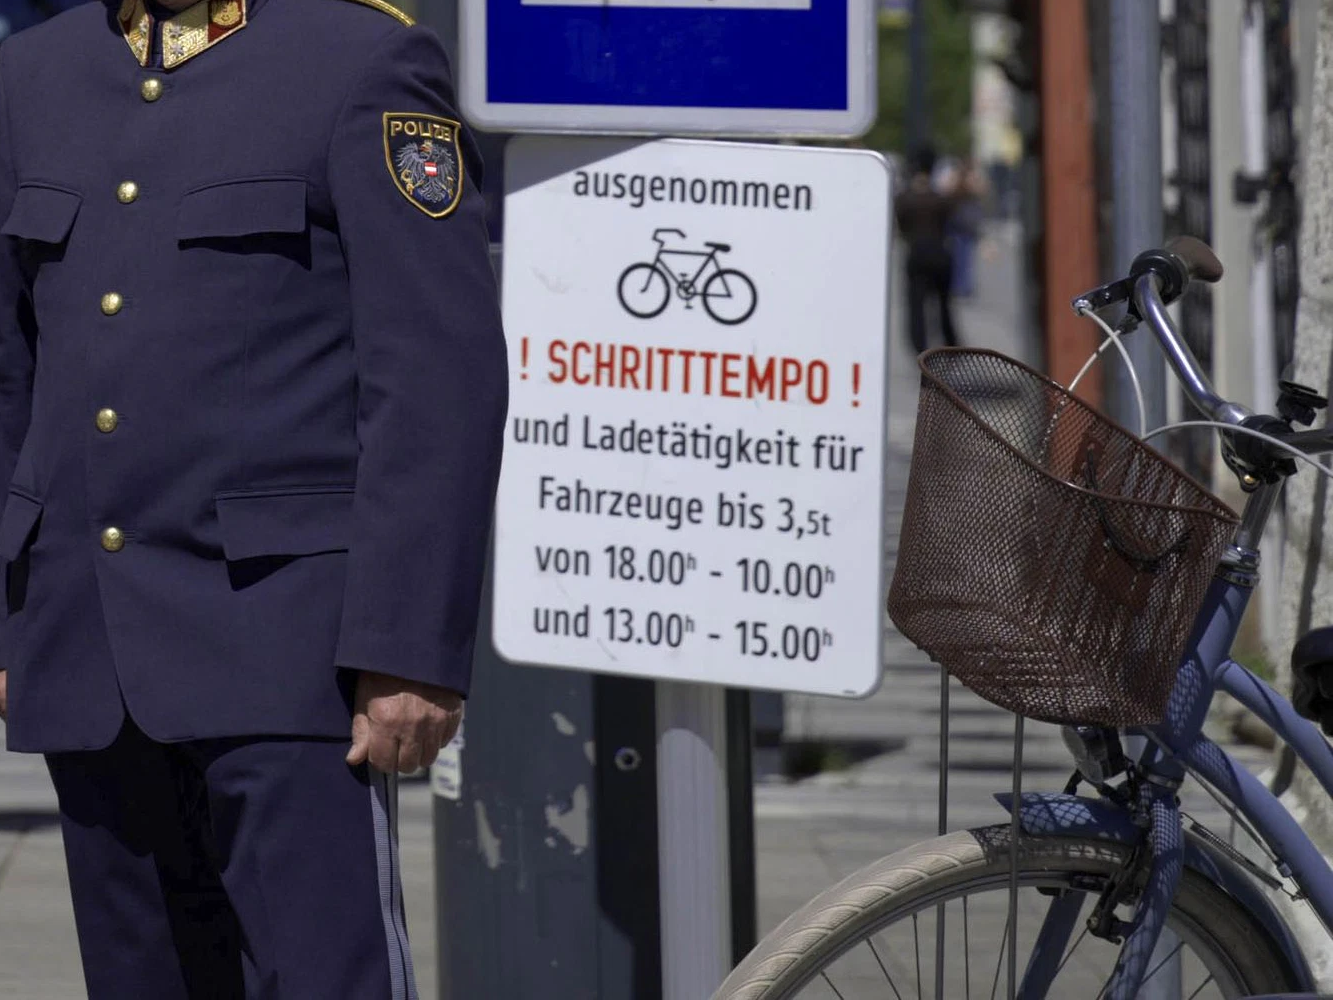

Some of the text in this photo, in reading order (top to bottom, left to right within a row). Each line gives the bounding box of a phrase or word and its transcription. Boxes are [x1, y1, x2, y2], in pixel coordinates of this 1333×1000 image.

[573, 170, 813, 211] ausgenommen
[520, 336, 861, 408] ! SCHRITTTEMPO !
[513, 414, 864, 473] und Ladetätigkeit für
[537, 476, 832, 540] Fahrzeuge bis 3,5t
[535, 545, 590, 576] von
[534, 605, 590, 639] und
